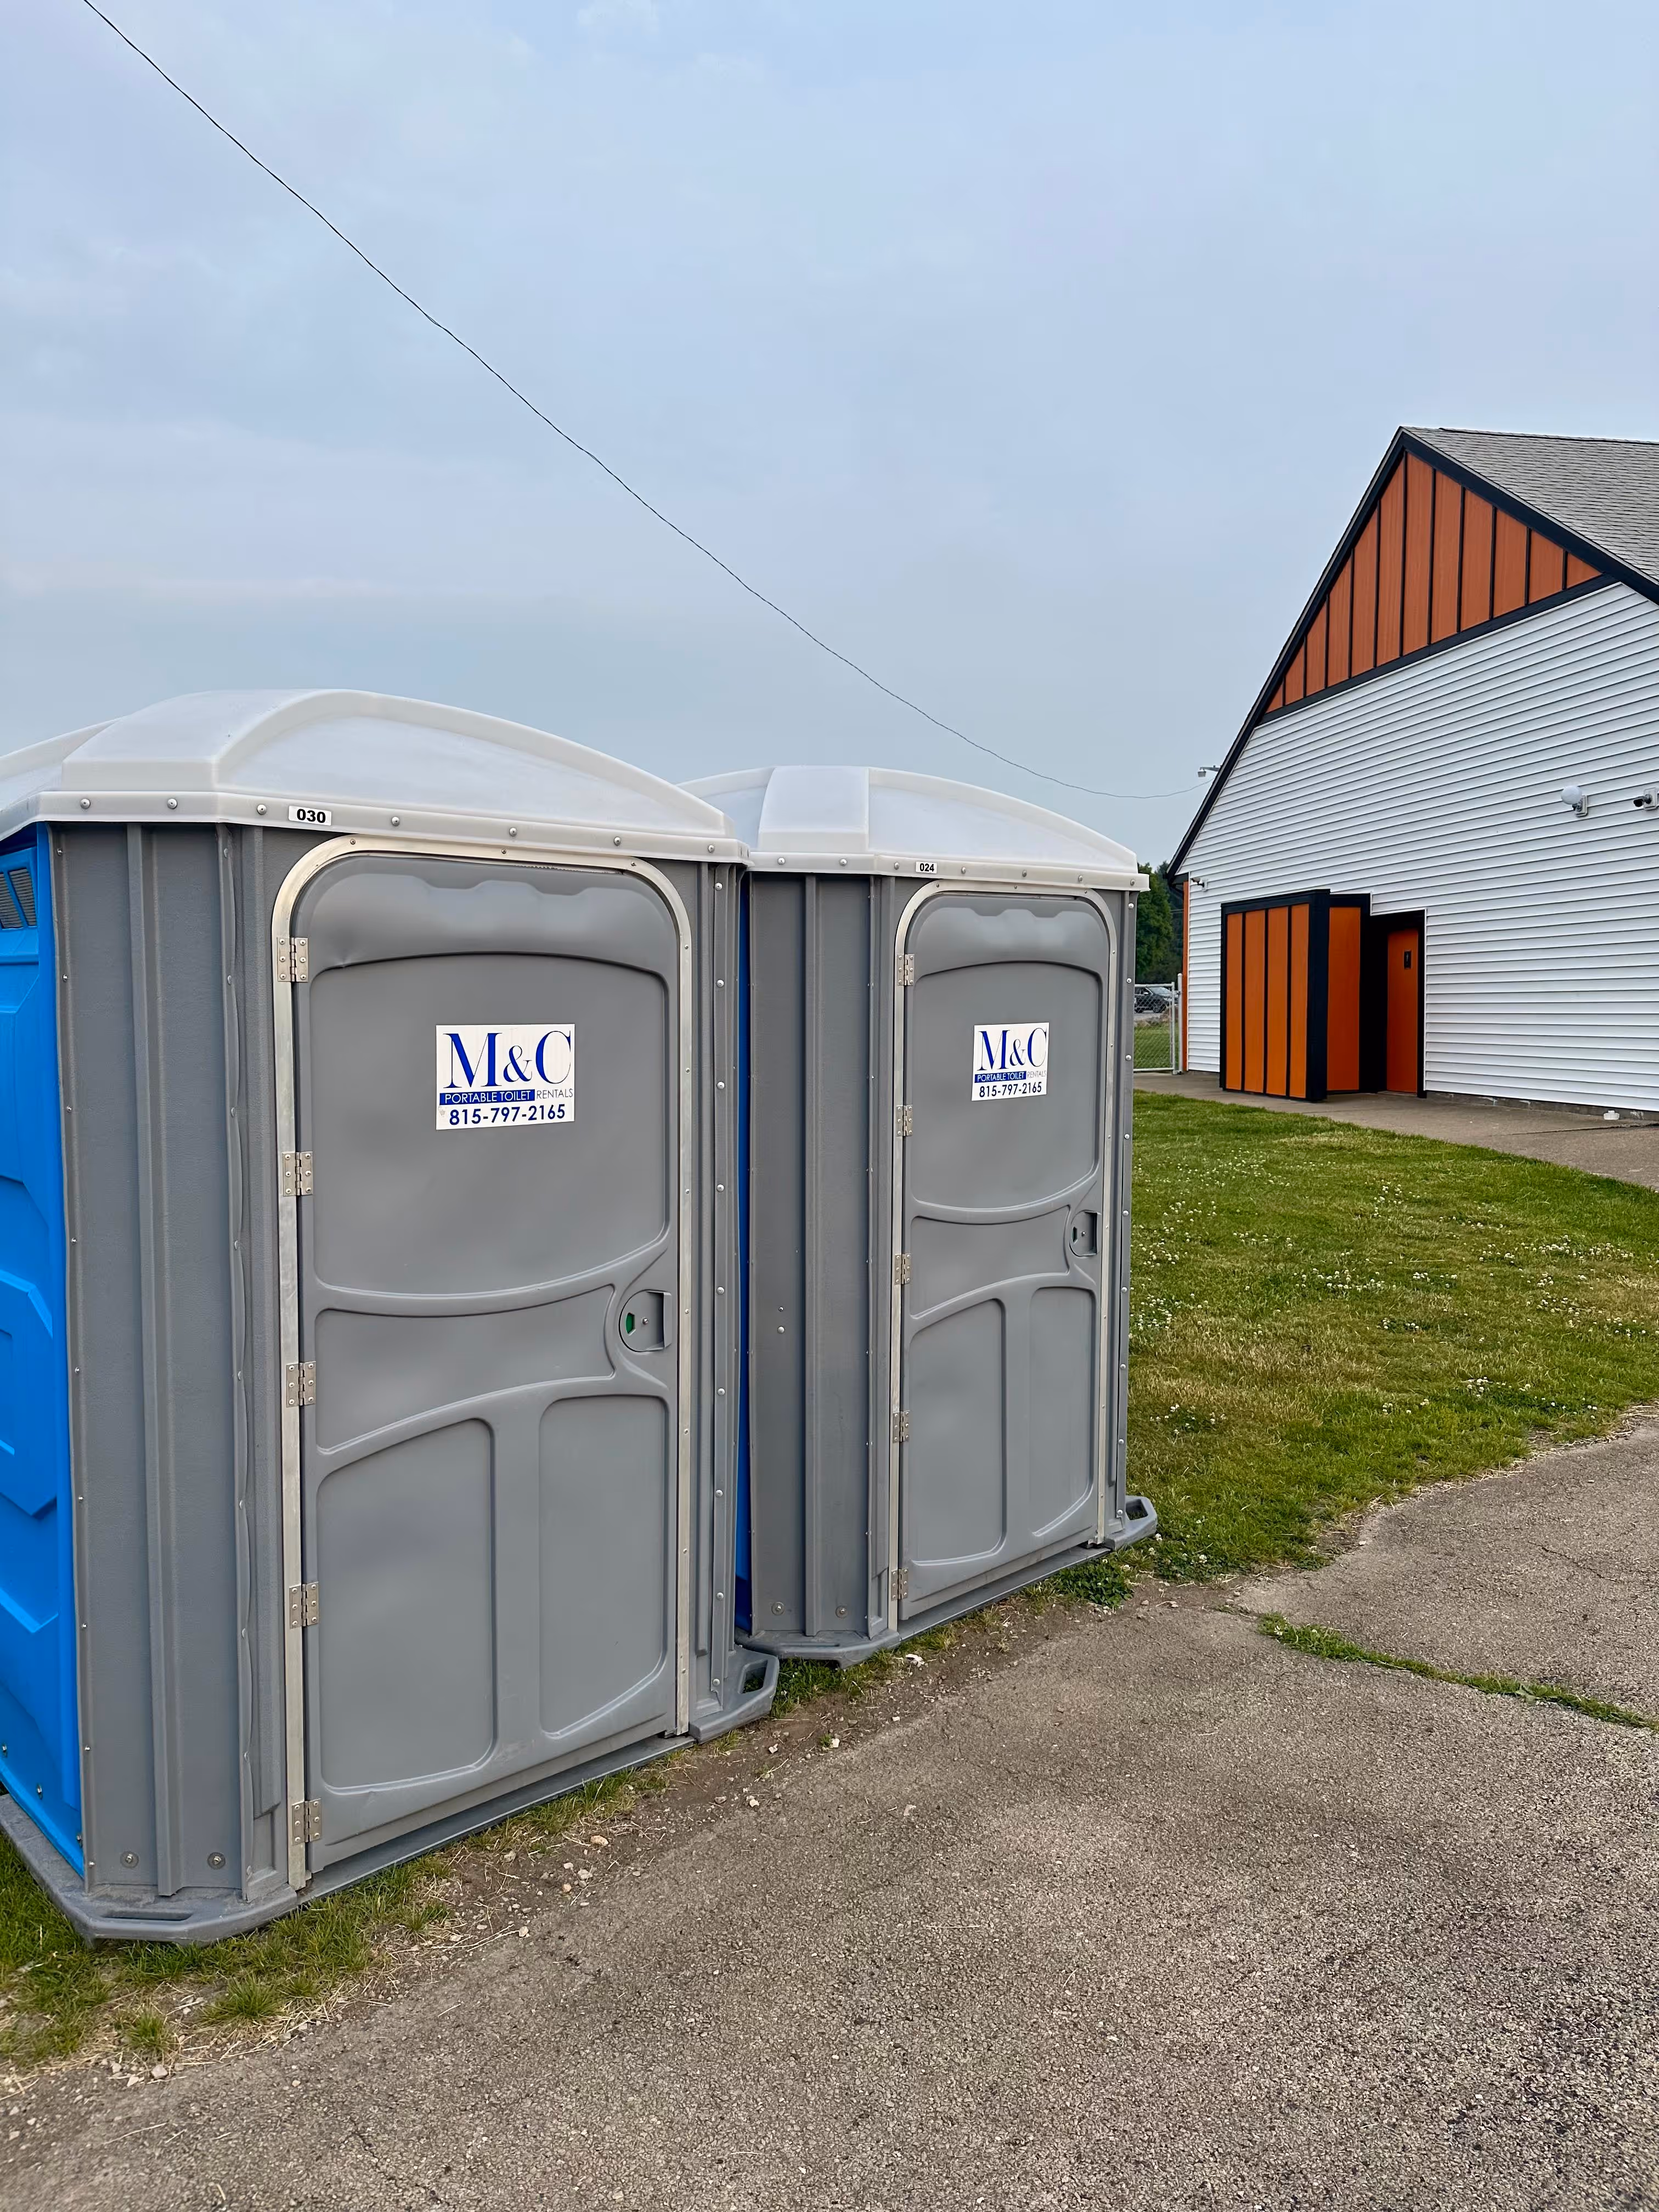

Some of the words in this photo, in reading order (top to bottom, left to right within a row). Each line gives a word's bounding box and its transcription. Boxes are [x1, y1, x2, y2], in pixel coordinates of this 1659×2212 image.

[297, 809, 326, 823] 030
[919, 863, 934, 872] 024
[977, 1028, 1047, 1071] M&C
[443, 1030, 571, 1088] M&C
[977, 1073, 1006, 1082] PORTABLE
[1007, 1071, 1025, 1080] TOILET
[1027, 1070, 1047, 1079] RENTALS
[445, 1092, 498, 1104] PORTABLE
[500, 1090, 531, 1101] TOILET
[537, 1088, 573, 1099] RENTALS
[979, 1081, 1042, 1098] 815-797-2165
[449, 1104, 566, 1125] 815-797-2165
